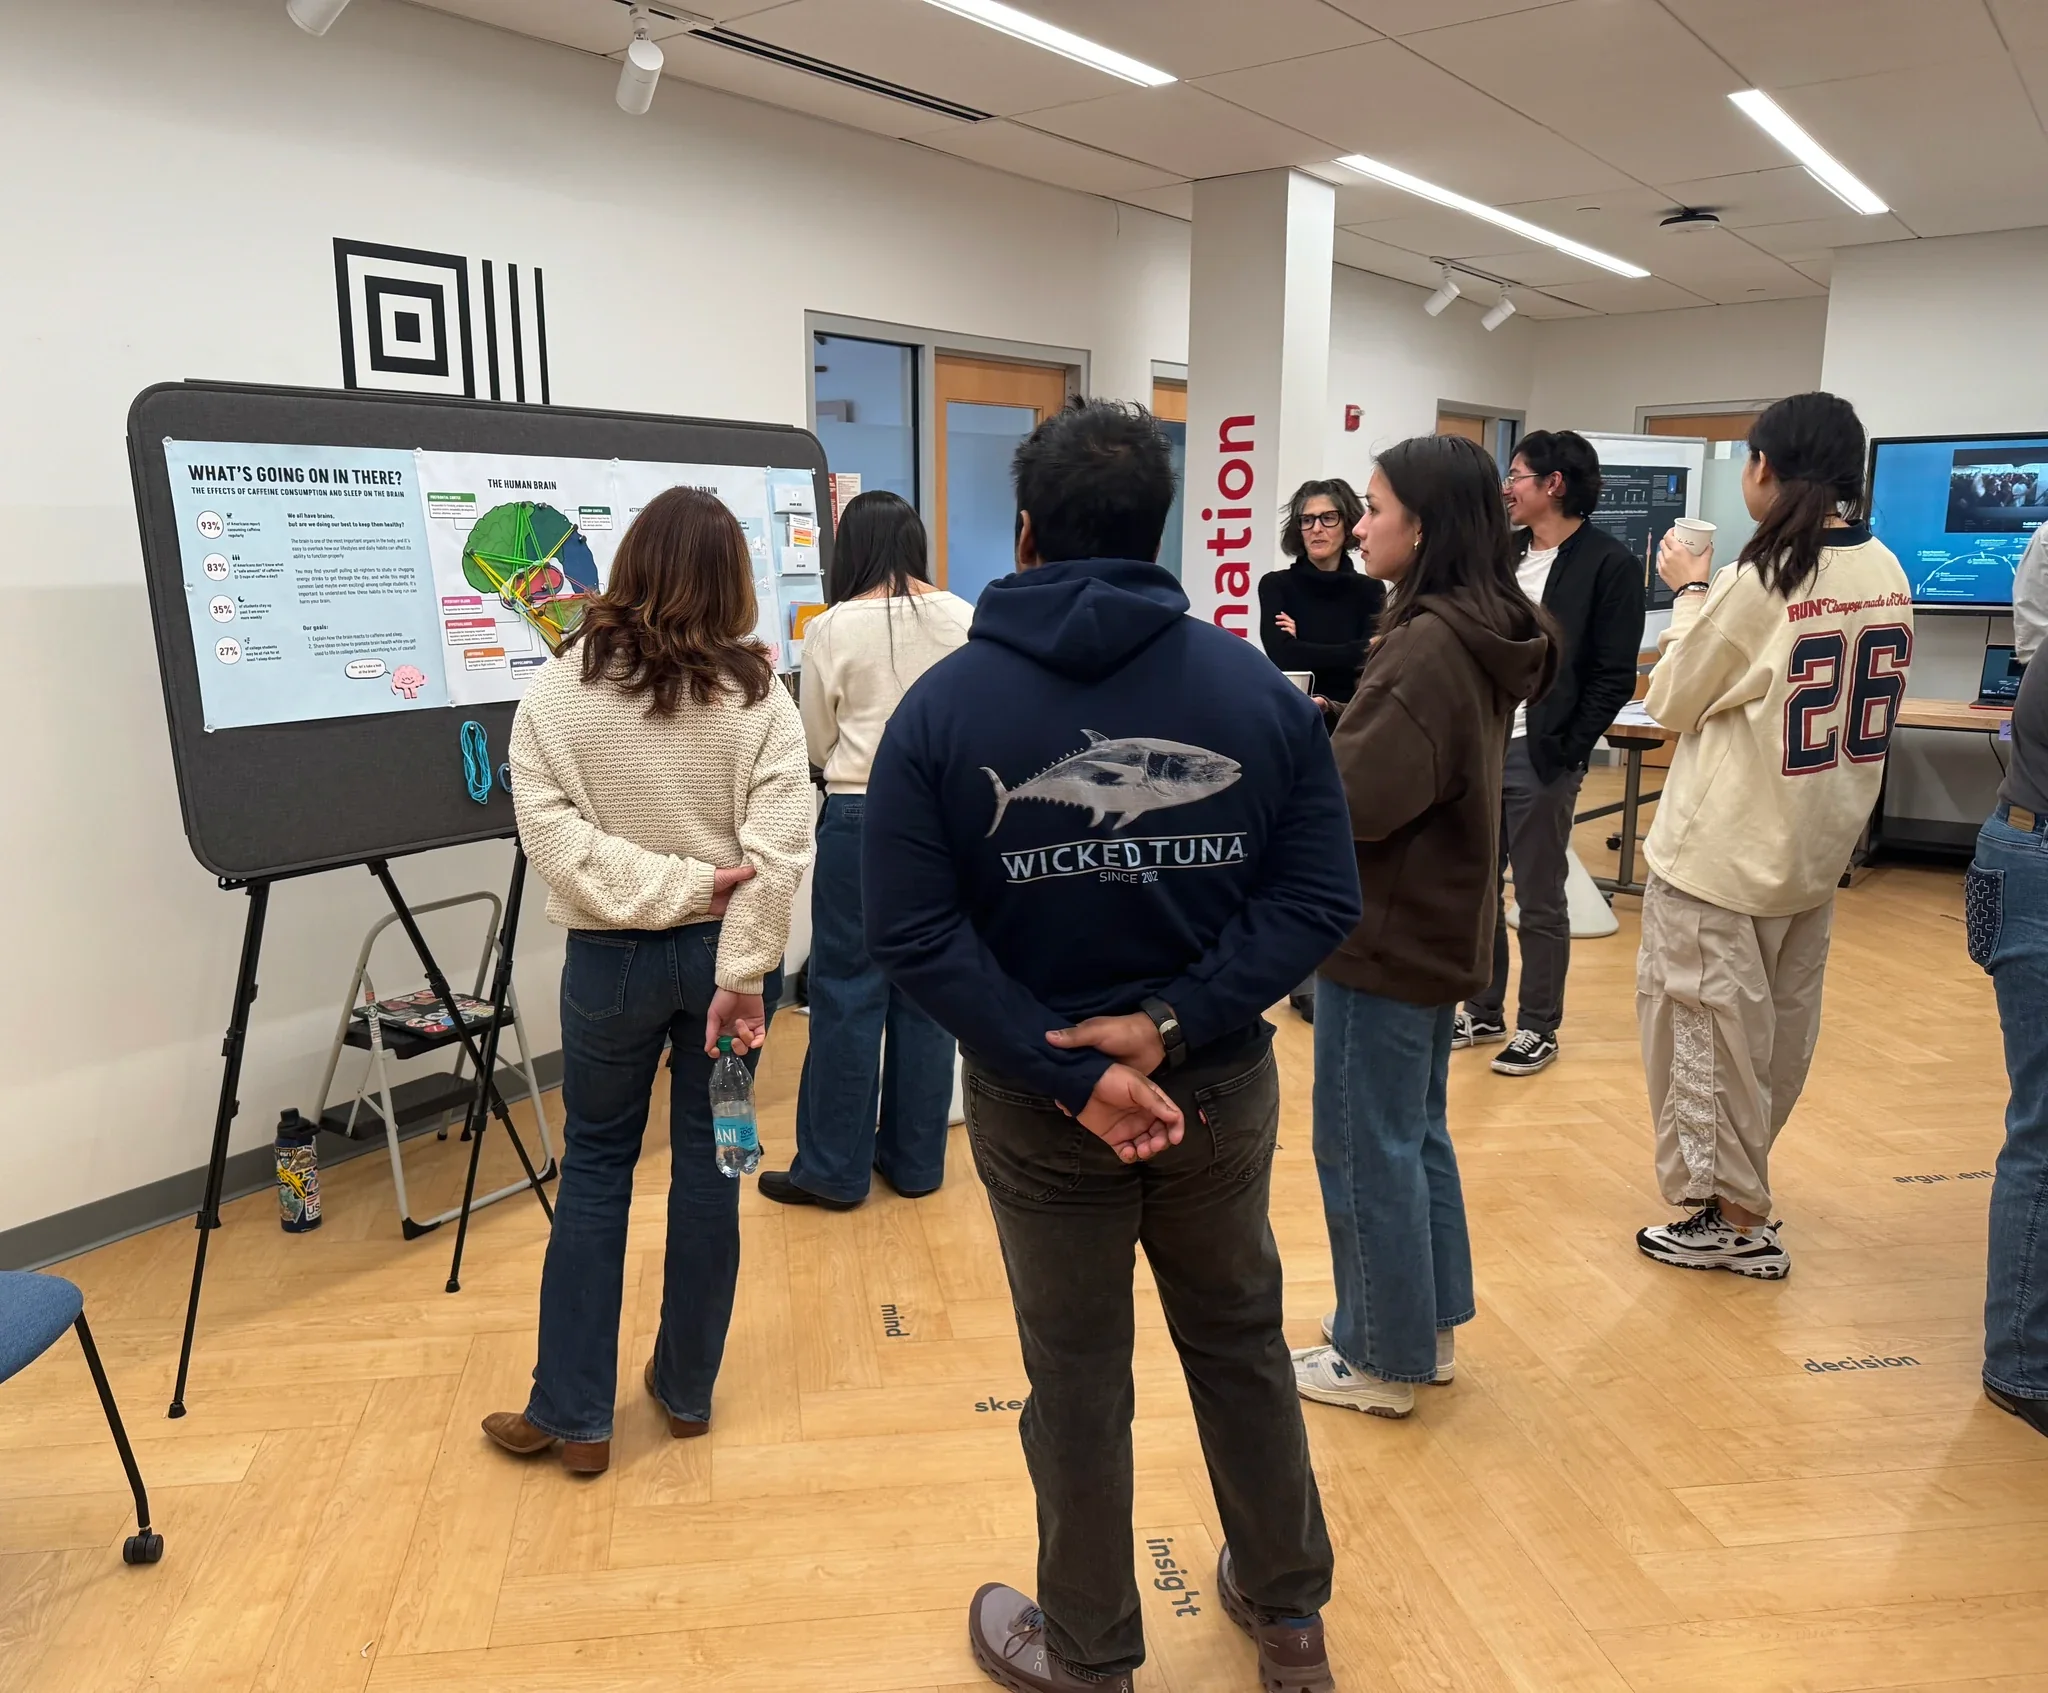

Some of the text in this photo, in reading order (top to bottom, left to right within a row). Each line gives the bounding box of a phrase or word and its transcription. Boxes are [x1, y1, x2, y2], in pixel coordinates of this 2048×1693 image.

[188, 464, 402, 485] WHAT'S GOING ON IN THERE?
[488, 479, 557, 490] THE HUMAN BRAIN
[201, 521, 220, 530] 93%
[207, 563, 226, 572] 83%
[213, 605, 232, 614] 35%
[1787, 599, 1822, 622] RUN
[219, 647, 238, 656] 27%
[1782, 622, 1913, 776] 26
[1001, 836, 1244, 879] WICKED TUNA
[1100, 872, 1138, 883] SINCE
[880, 1304, 910, 1338] mind
[1804, 1354, 1921, 1374] decision
[975, 1396, 1028, 1412] ske
[1146, 1537, 1201, 1617] insight
